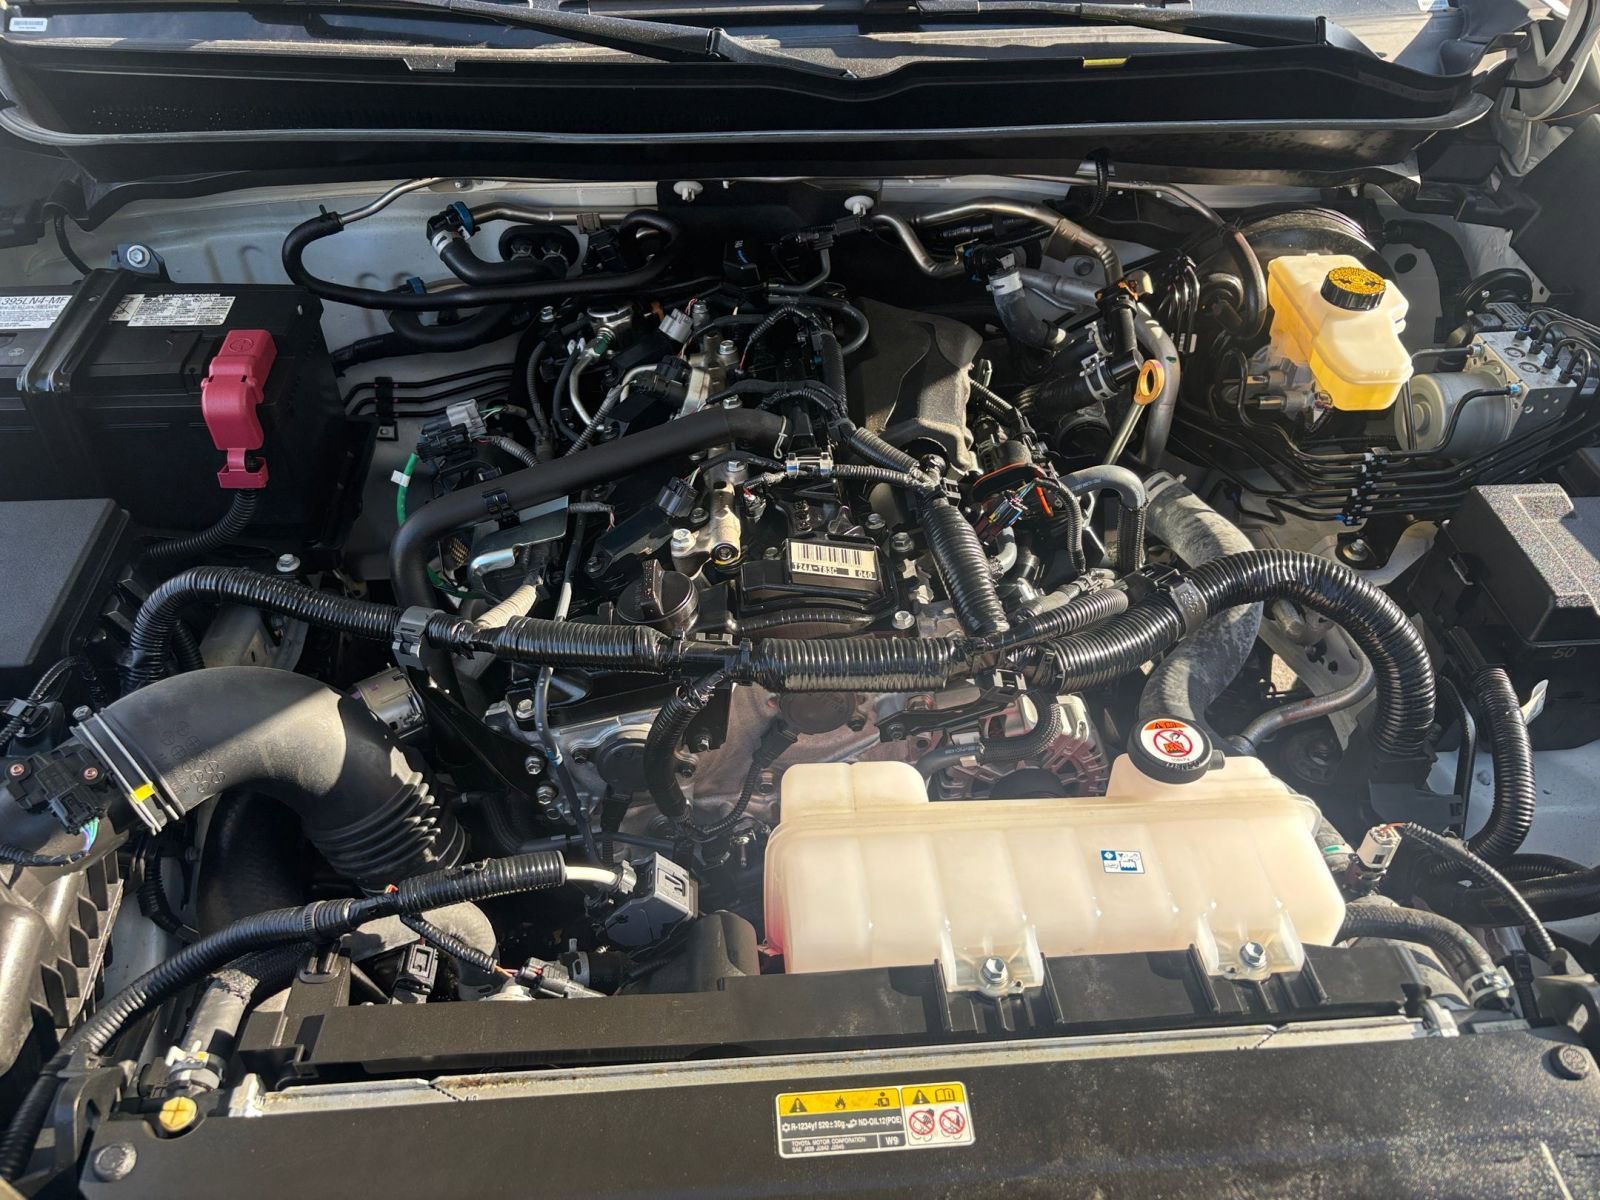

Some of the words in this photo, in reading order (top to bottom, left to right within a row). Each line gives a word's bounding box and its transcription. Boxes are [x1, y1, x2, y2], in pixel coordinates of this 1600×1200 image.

[858, 570, 873, 579] 040
[790, 1121, 817, 1131] R-1234yf
[818, 1119, 846, 1129] 520±30g
[858, 1116, 902, 1126] ND-OIL12(POE)
[831, 1136, 867, 1145] CORPORATION
[885, 1136, 899, 1146] W9
